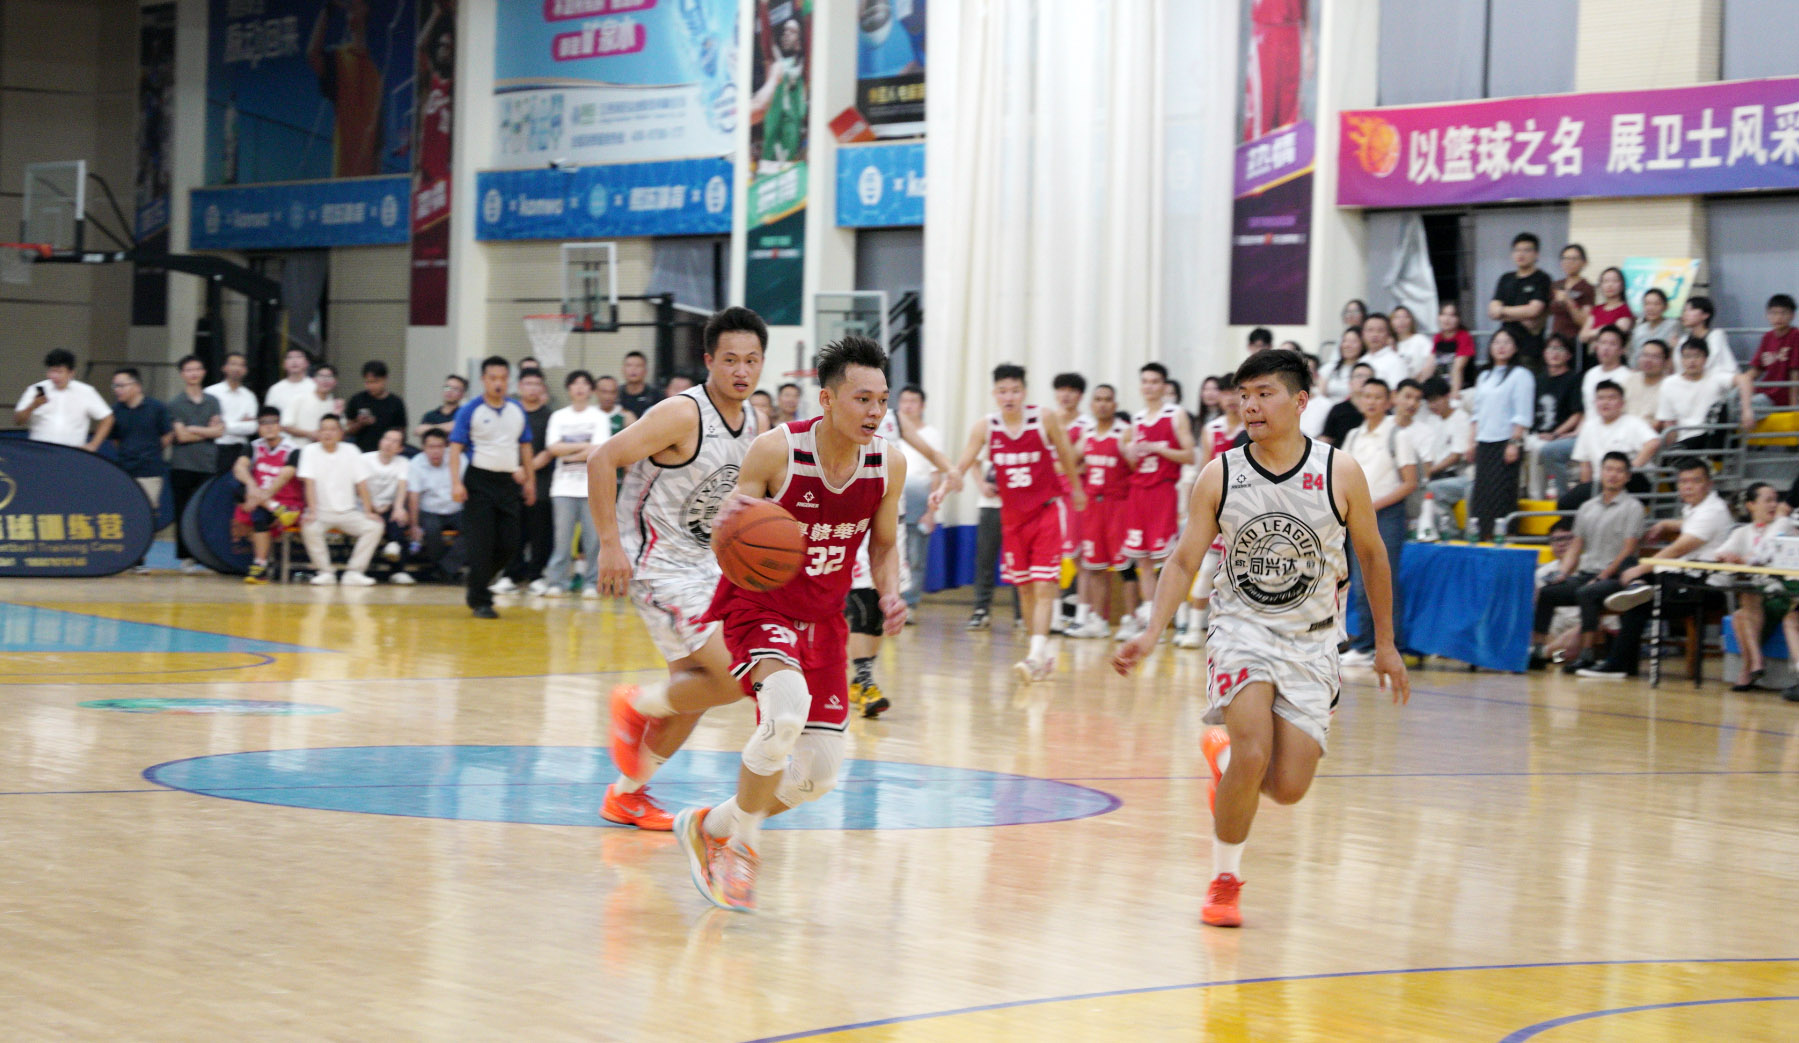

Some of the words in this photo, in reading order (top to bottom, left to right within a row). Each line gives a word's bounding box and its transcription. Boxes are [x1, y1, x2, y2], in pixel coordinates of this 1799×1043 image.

[1407, 116, 1585, 185] 以篮球之名
[1606, 102, 1799, 174] 展卫士风采
[1303, 472, 1324, 491] 24
[0, 513, 124, 541] 球训练营
[1235, 531, 1258, 557] TXD
[1262, 519, 1317, 558] LEAGUE
[805, 545, 847, 577] 32
[1250, 557, 1298, 577] 同兴达
[1216, 666, 1250, 697] 24
